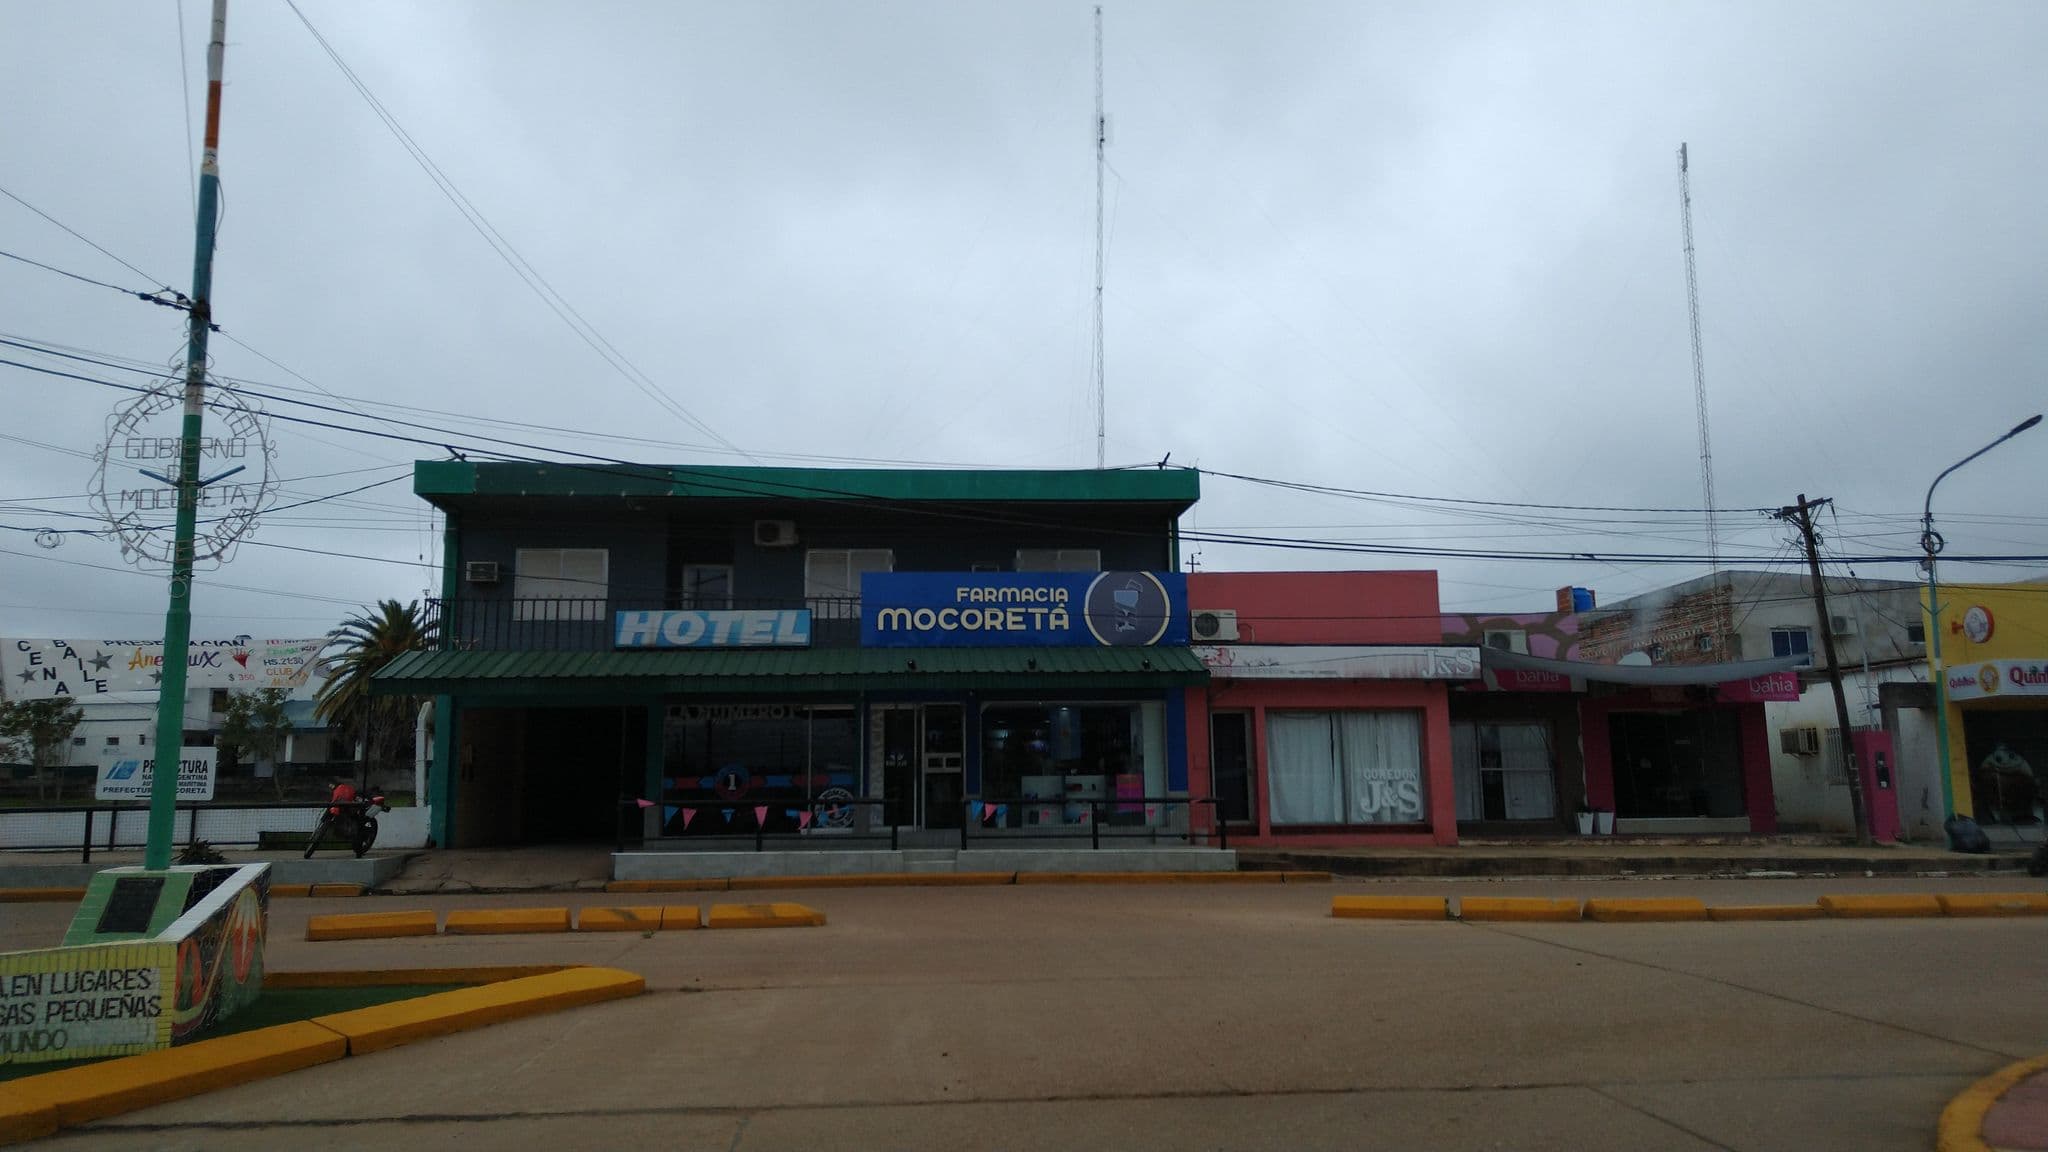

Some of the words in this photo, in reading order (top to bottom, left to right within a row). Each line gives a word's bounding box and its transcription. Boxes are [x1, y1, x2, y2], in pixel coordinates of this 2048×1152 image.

[125, 437, 246, 459] GOBIRNO
[120, 484, 247, 510] MOCETA
[956, 587, 1069, 603] FARMACIA
[618, 611, 807, 645] HOTEL
[2008, 665, 2048, 687] Quin
[50, 968, 152, 994] LUGARES
[46, 993, 162, 1025] PEQUEÑAS
